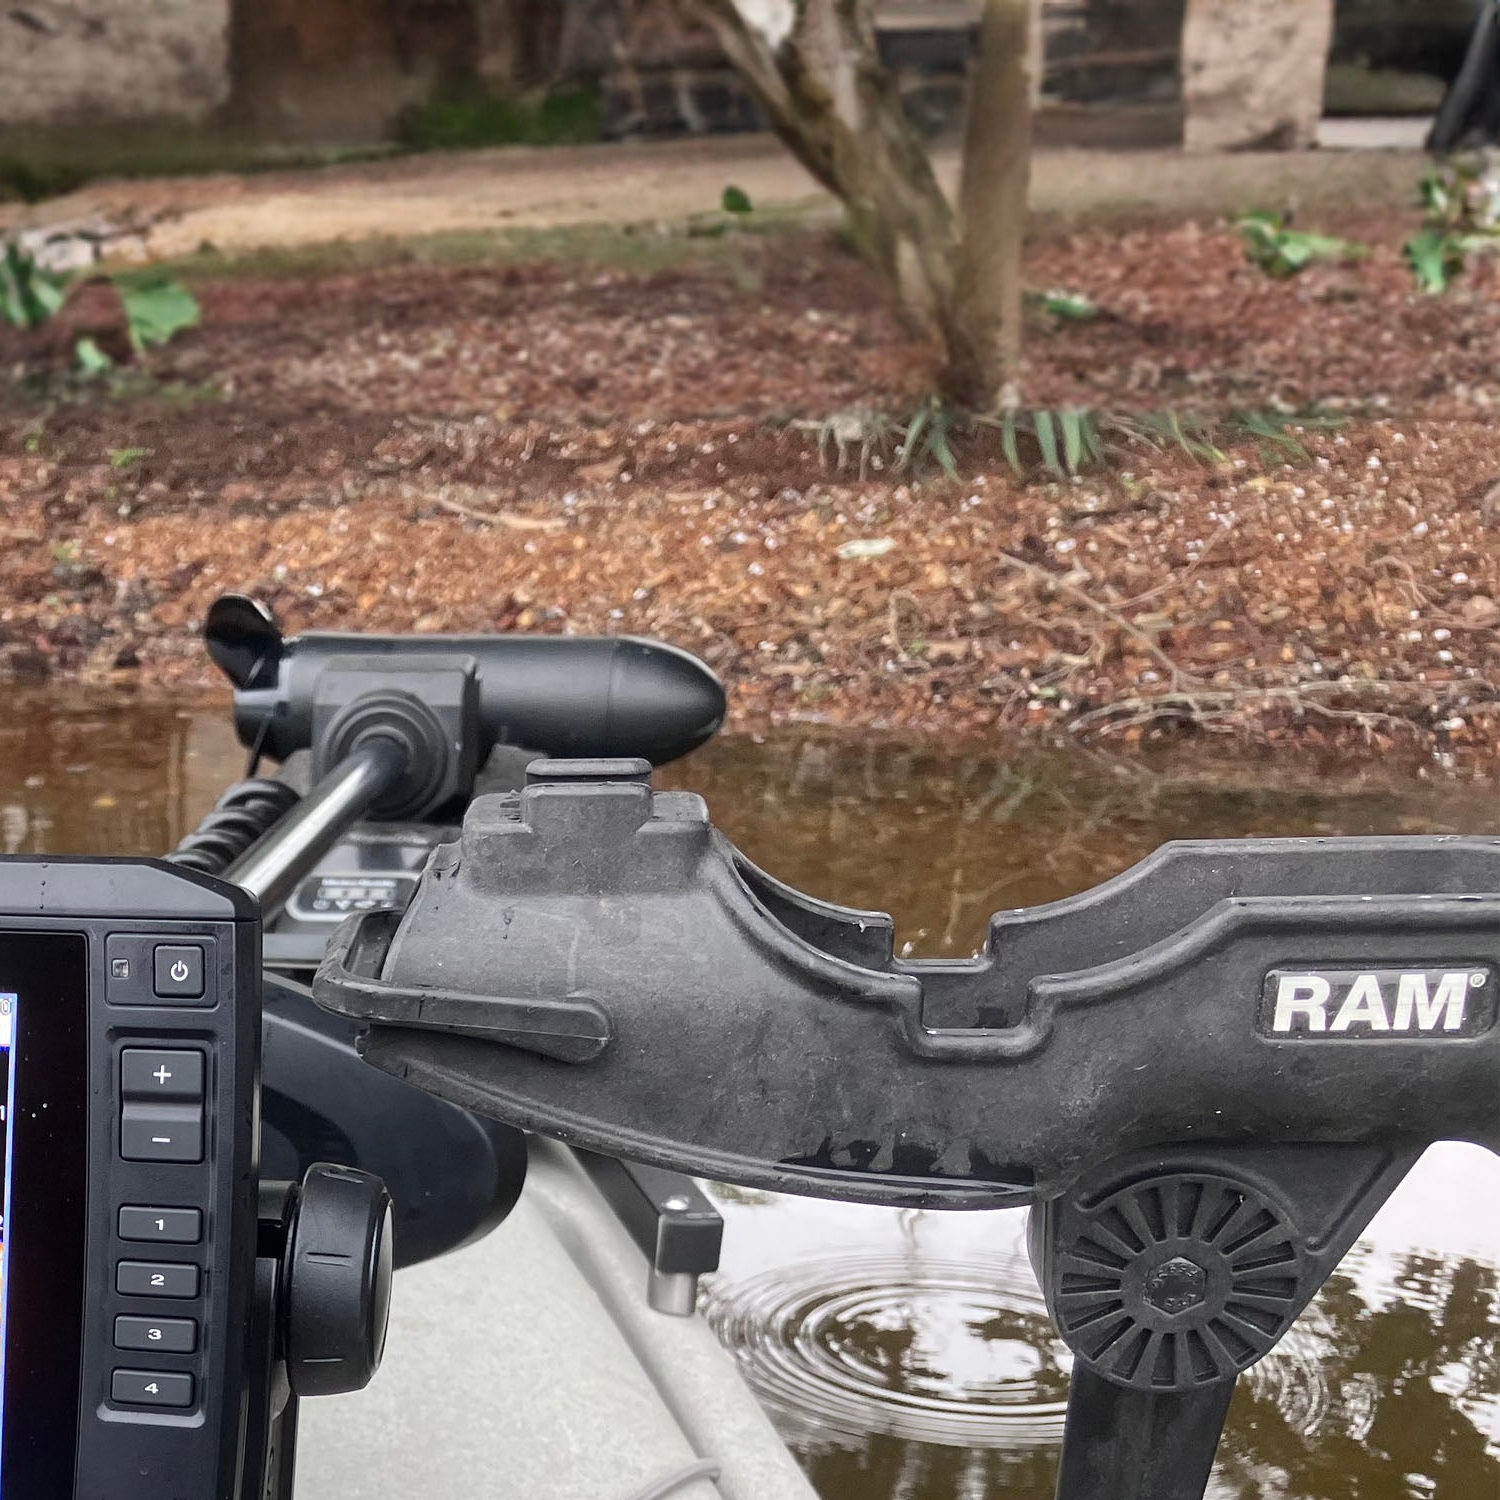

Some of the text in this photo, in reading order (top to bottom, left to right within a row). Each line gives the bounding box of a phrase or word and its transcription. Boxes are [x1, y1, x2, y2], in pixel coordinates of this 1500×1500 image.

[156, 1219, 165, 1231] 1
[150, 1274, 165, 1286] 2
[147, 1328, 162, 1340] 3
[144, 1383, 159, 1394] 4
